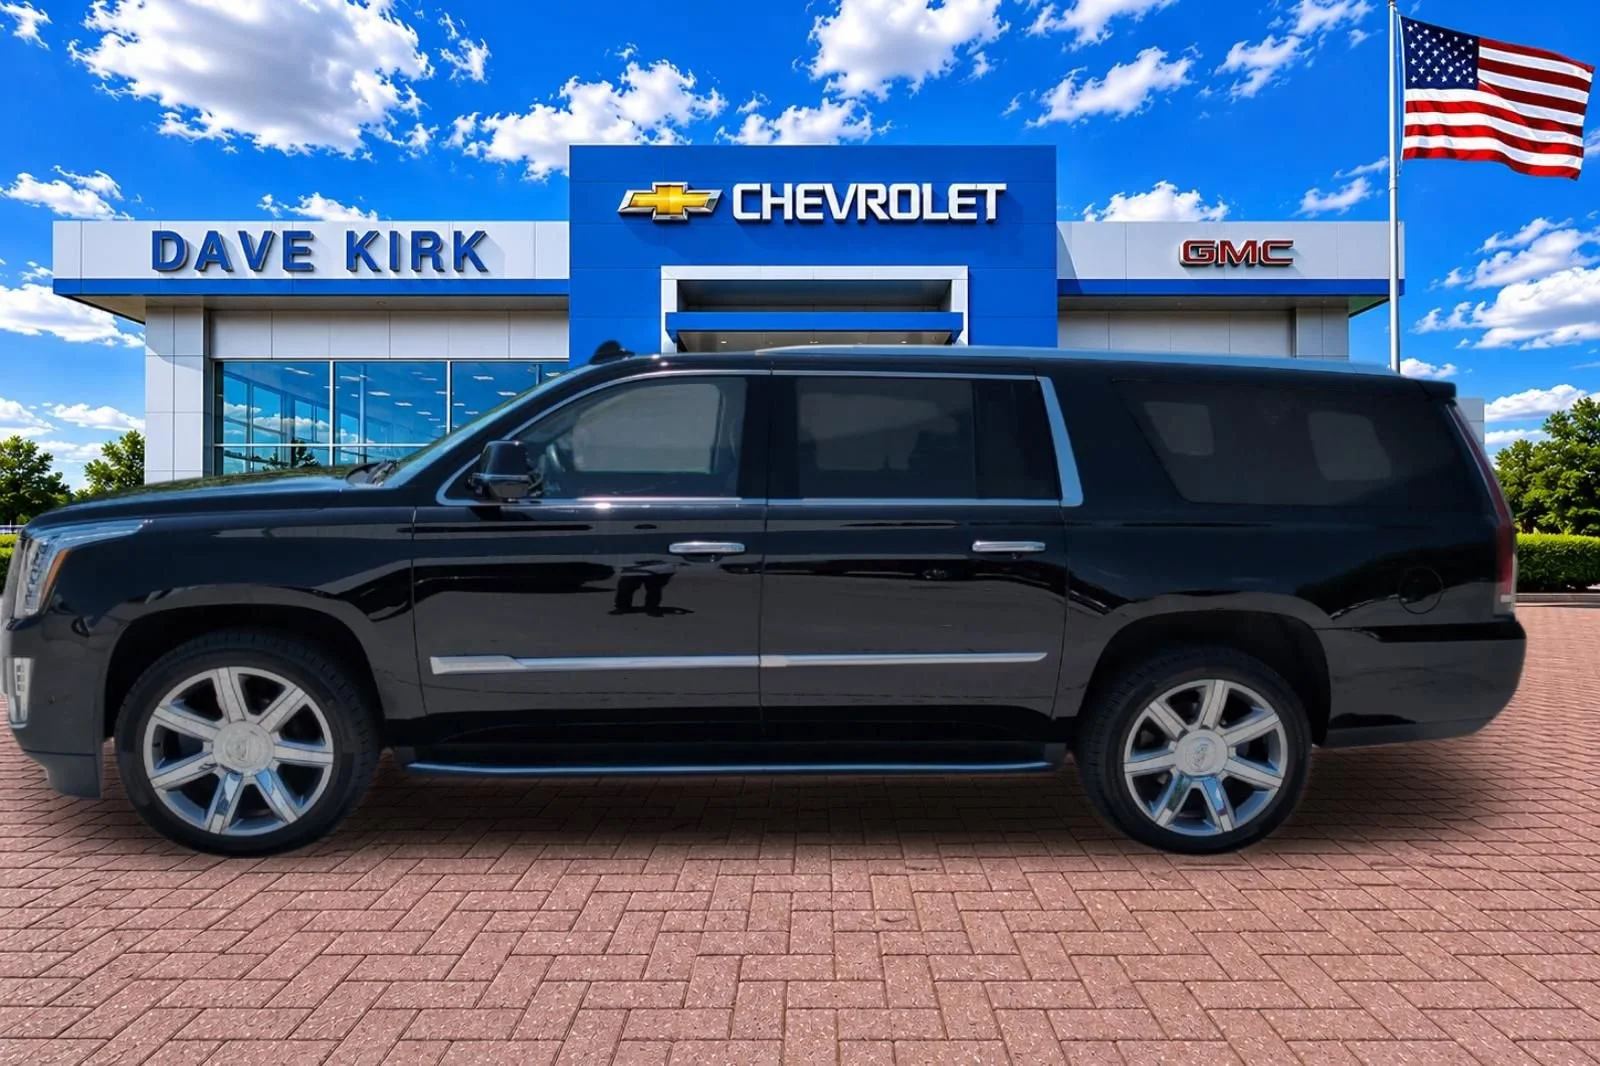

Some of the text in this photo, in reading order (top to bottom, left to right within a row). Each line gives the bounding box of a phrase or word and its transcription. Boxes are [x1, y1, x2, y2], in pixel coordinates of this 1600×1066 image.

[732, 183, 1008, 221] CHEVROLET
[151, 230, 489, 272] DAVE KIRK
[1180, 239, 1294, 266] GMC
